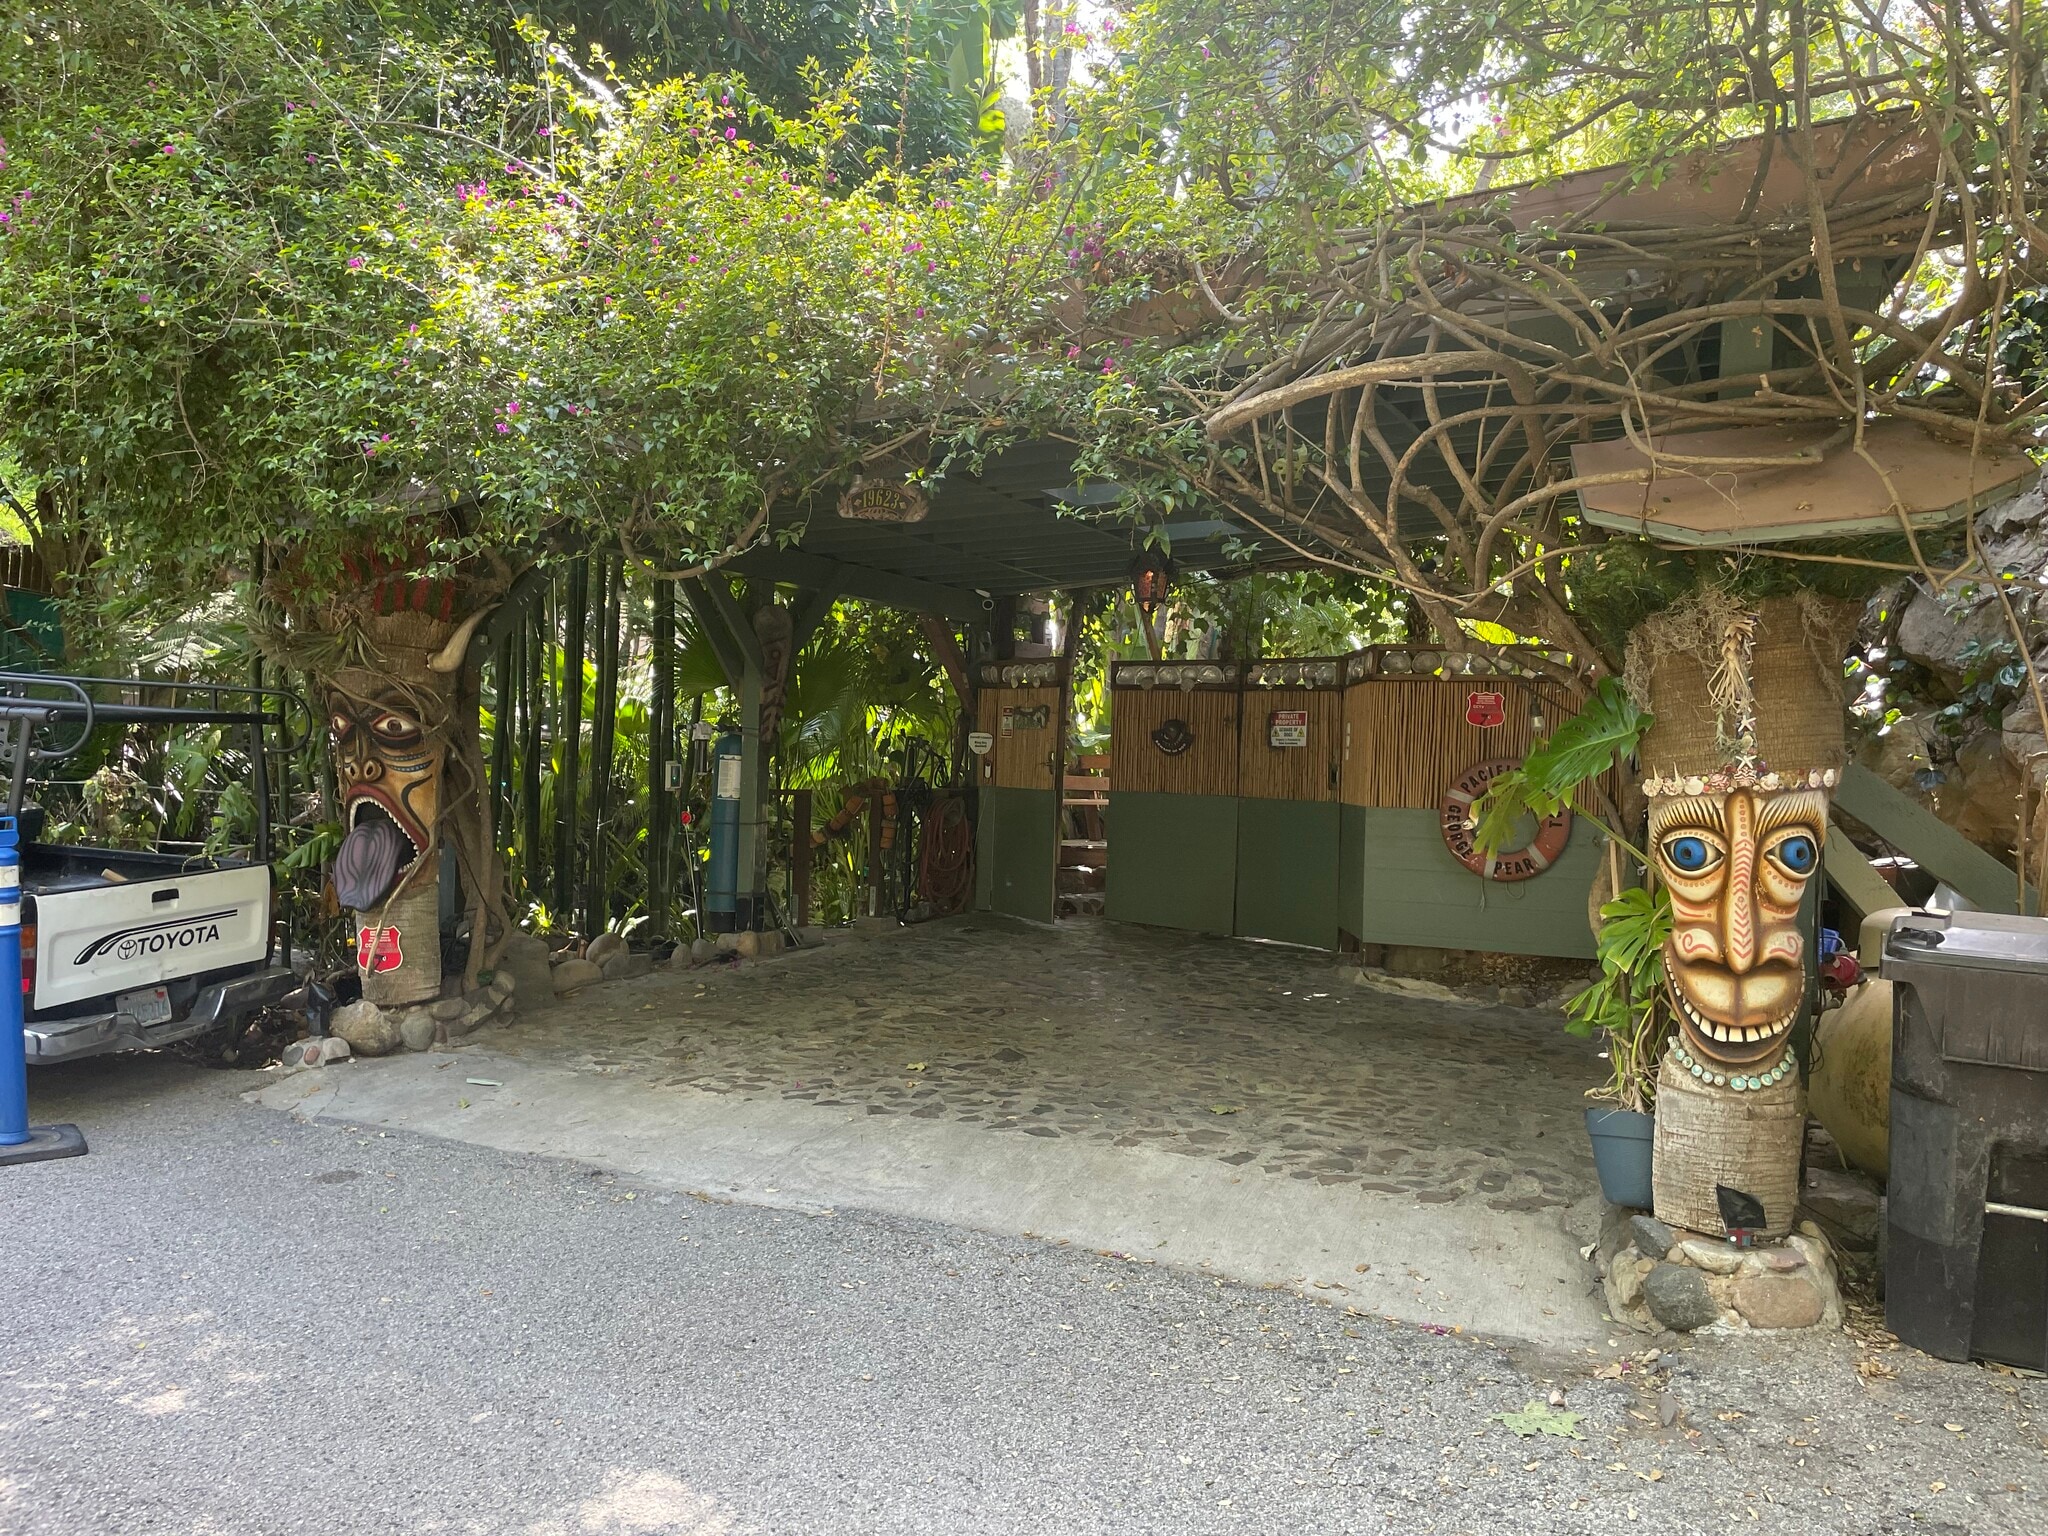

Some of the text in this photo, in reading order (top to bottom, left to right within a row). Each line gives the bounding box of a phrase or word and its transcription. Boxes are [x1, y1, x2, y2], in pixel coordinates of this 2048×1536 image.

[863, 489, 900, 510] 19623
[1446, 804, 1474, 859] GEORGE
[1493, 858, 1535, 876] PEAR
[138, 924, 220, 956] TOYOTA
